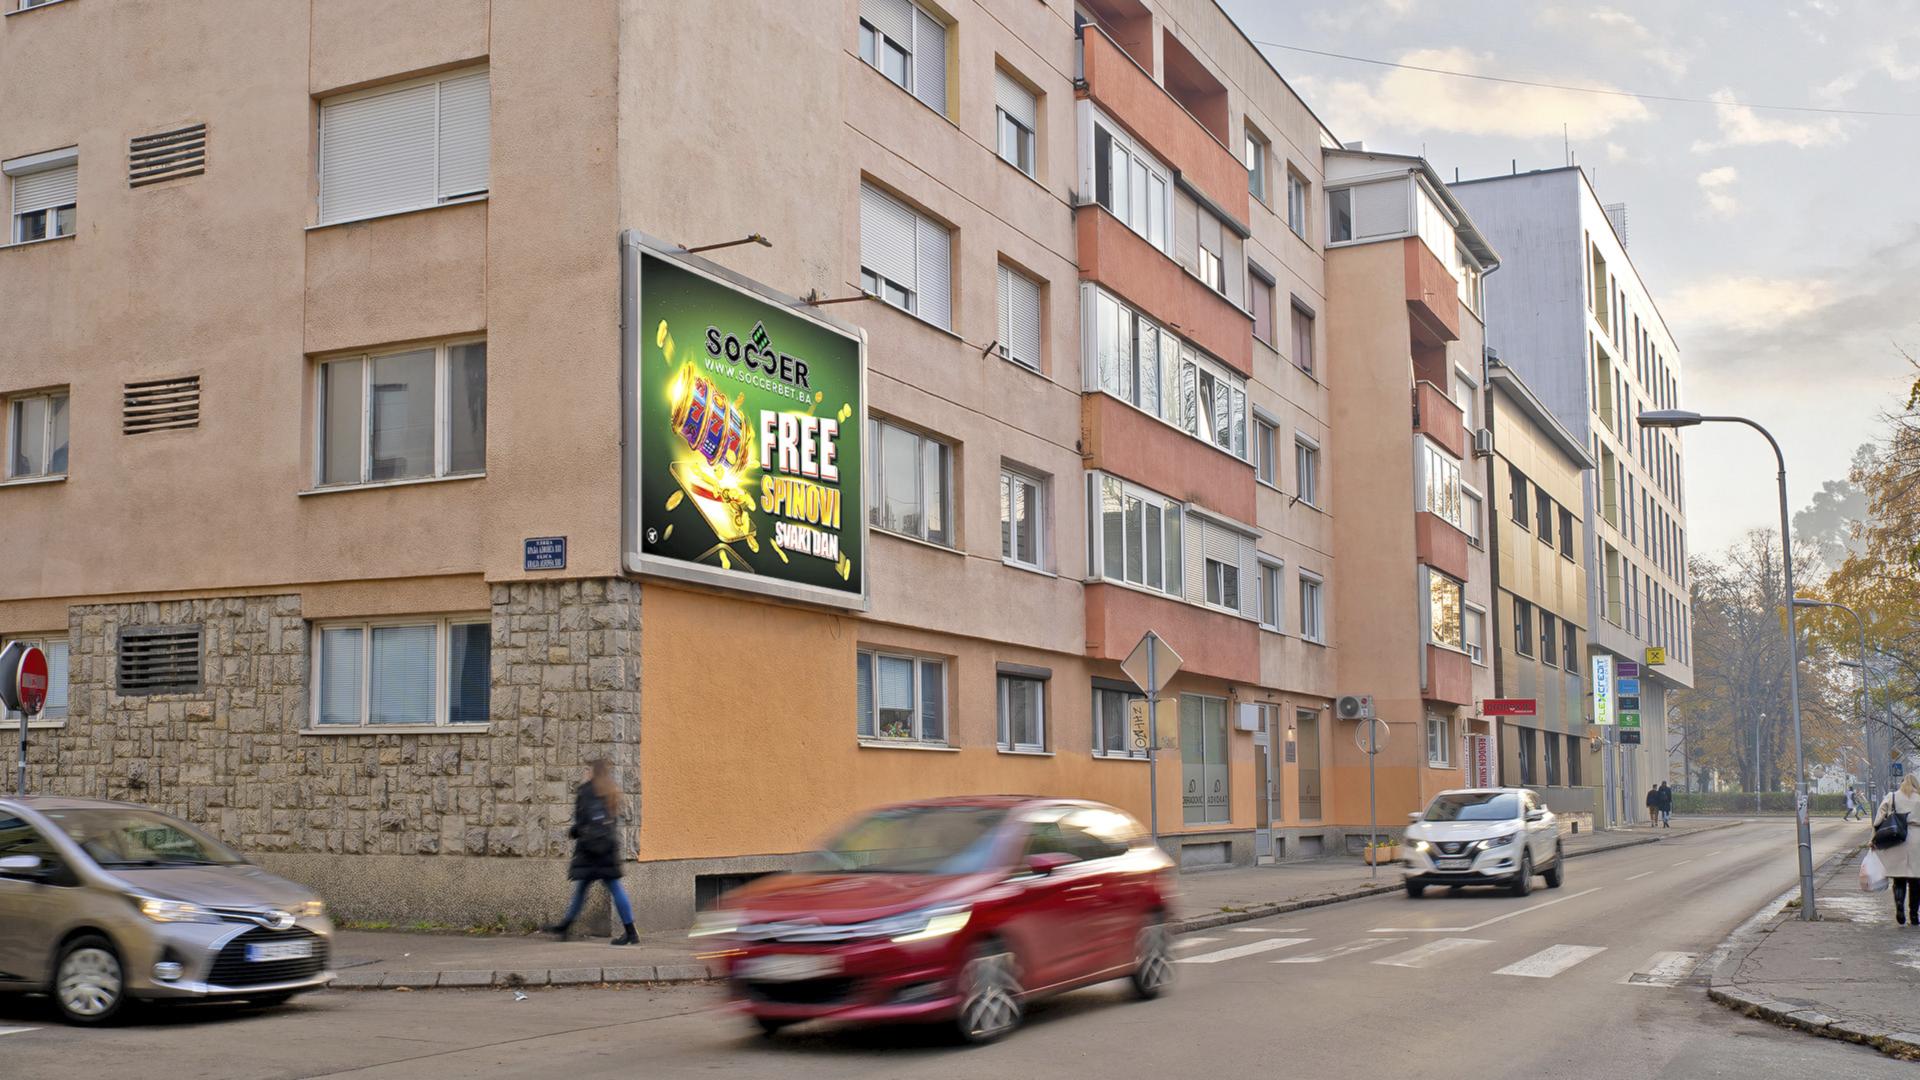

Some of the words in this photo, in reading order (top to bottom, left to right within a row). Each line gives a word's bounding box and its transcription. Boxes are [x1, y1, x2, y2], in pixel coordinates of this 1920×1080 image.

[704, 358, 812, 405] WWW.SOCCERBET.BA
[705, 327, 811, 390] SOCCER
[760, 410, 839, 483] FREE
[760, 474, 841, 530] SPINOVI
[775, 521, 812, 556] SVAKI
[812, 530, 839, 562] DAN
[1479, 737, 1487, 767] RENDGEN
